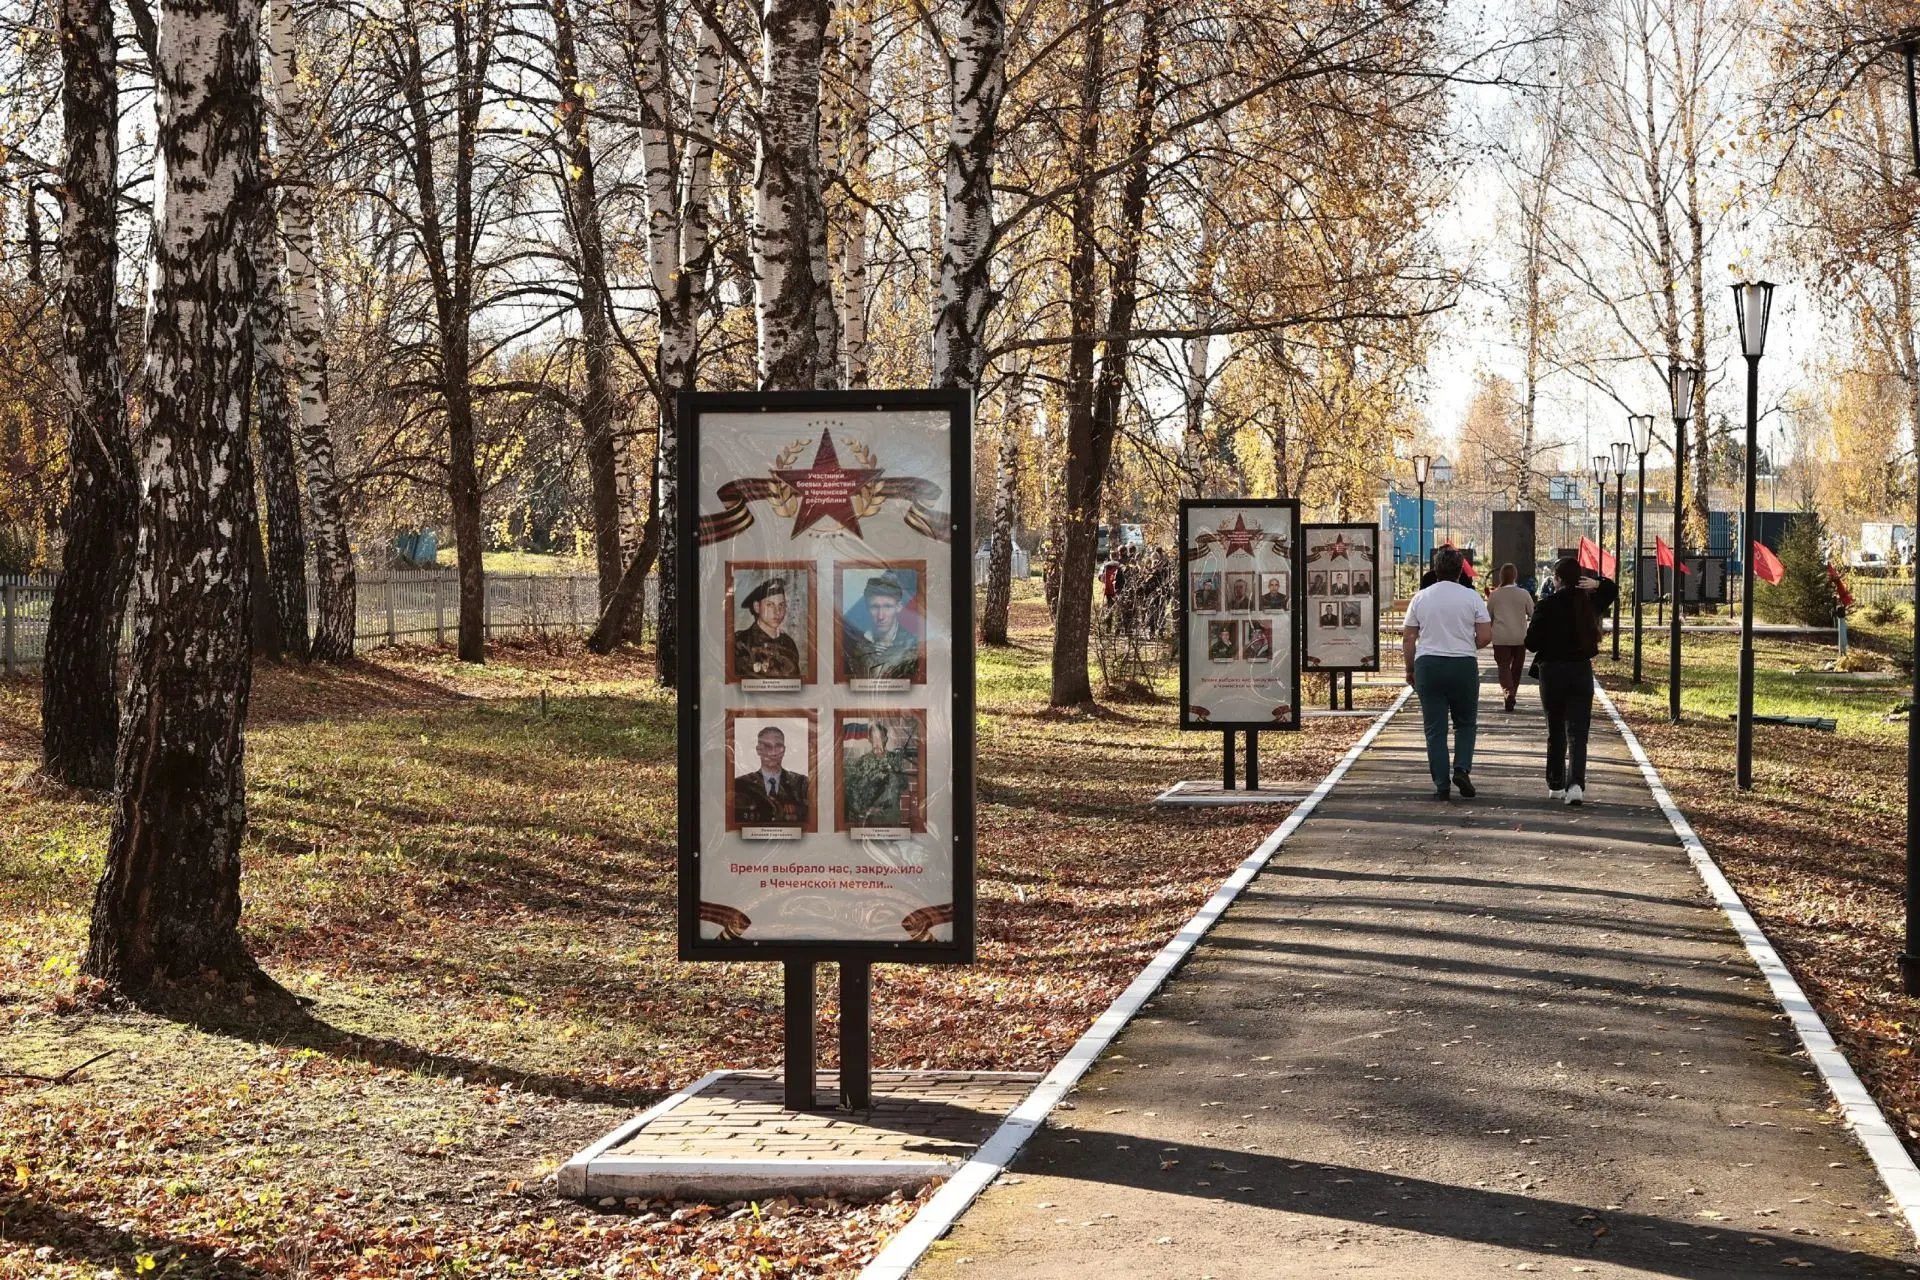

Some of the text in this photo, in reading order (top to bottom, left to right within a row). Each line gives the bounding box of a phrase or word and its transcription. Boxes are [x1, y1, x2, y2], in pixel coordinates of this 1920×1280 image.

[730, 862, 923, 875] Время выбрало нас, закружило
[760, 878, 893, 889] в Чеченской метели...
